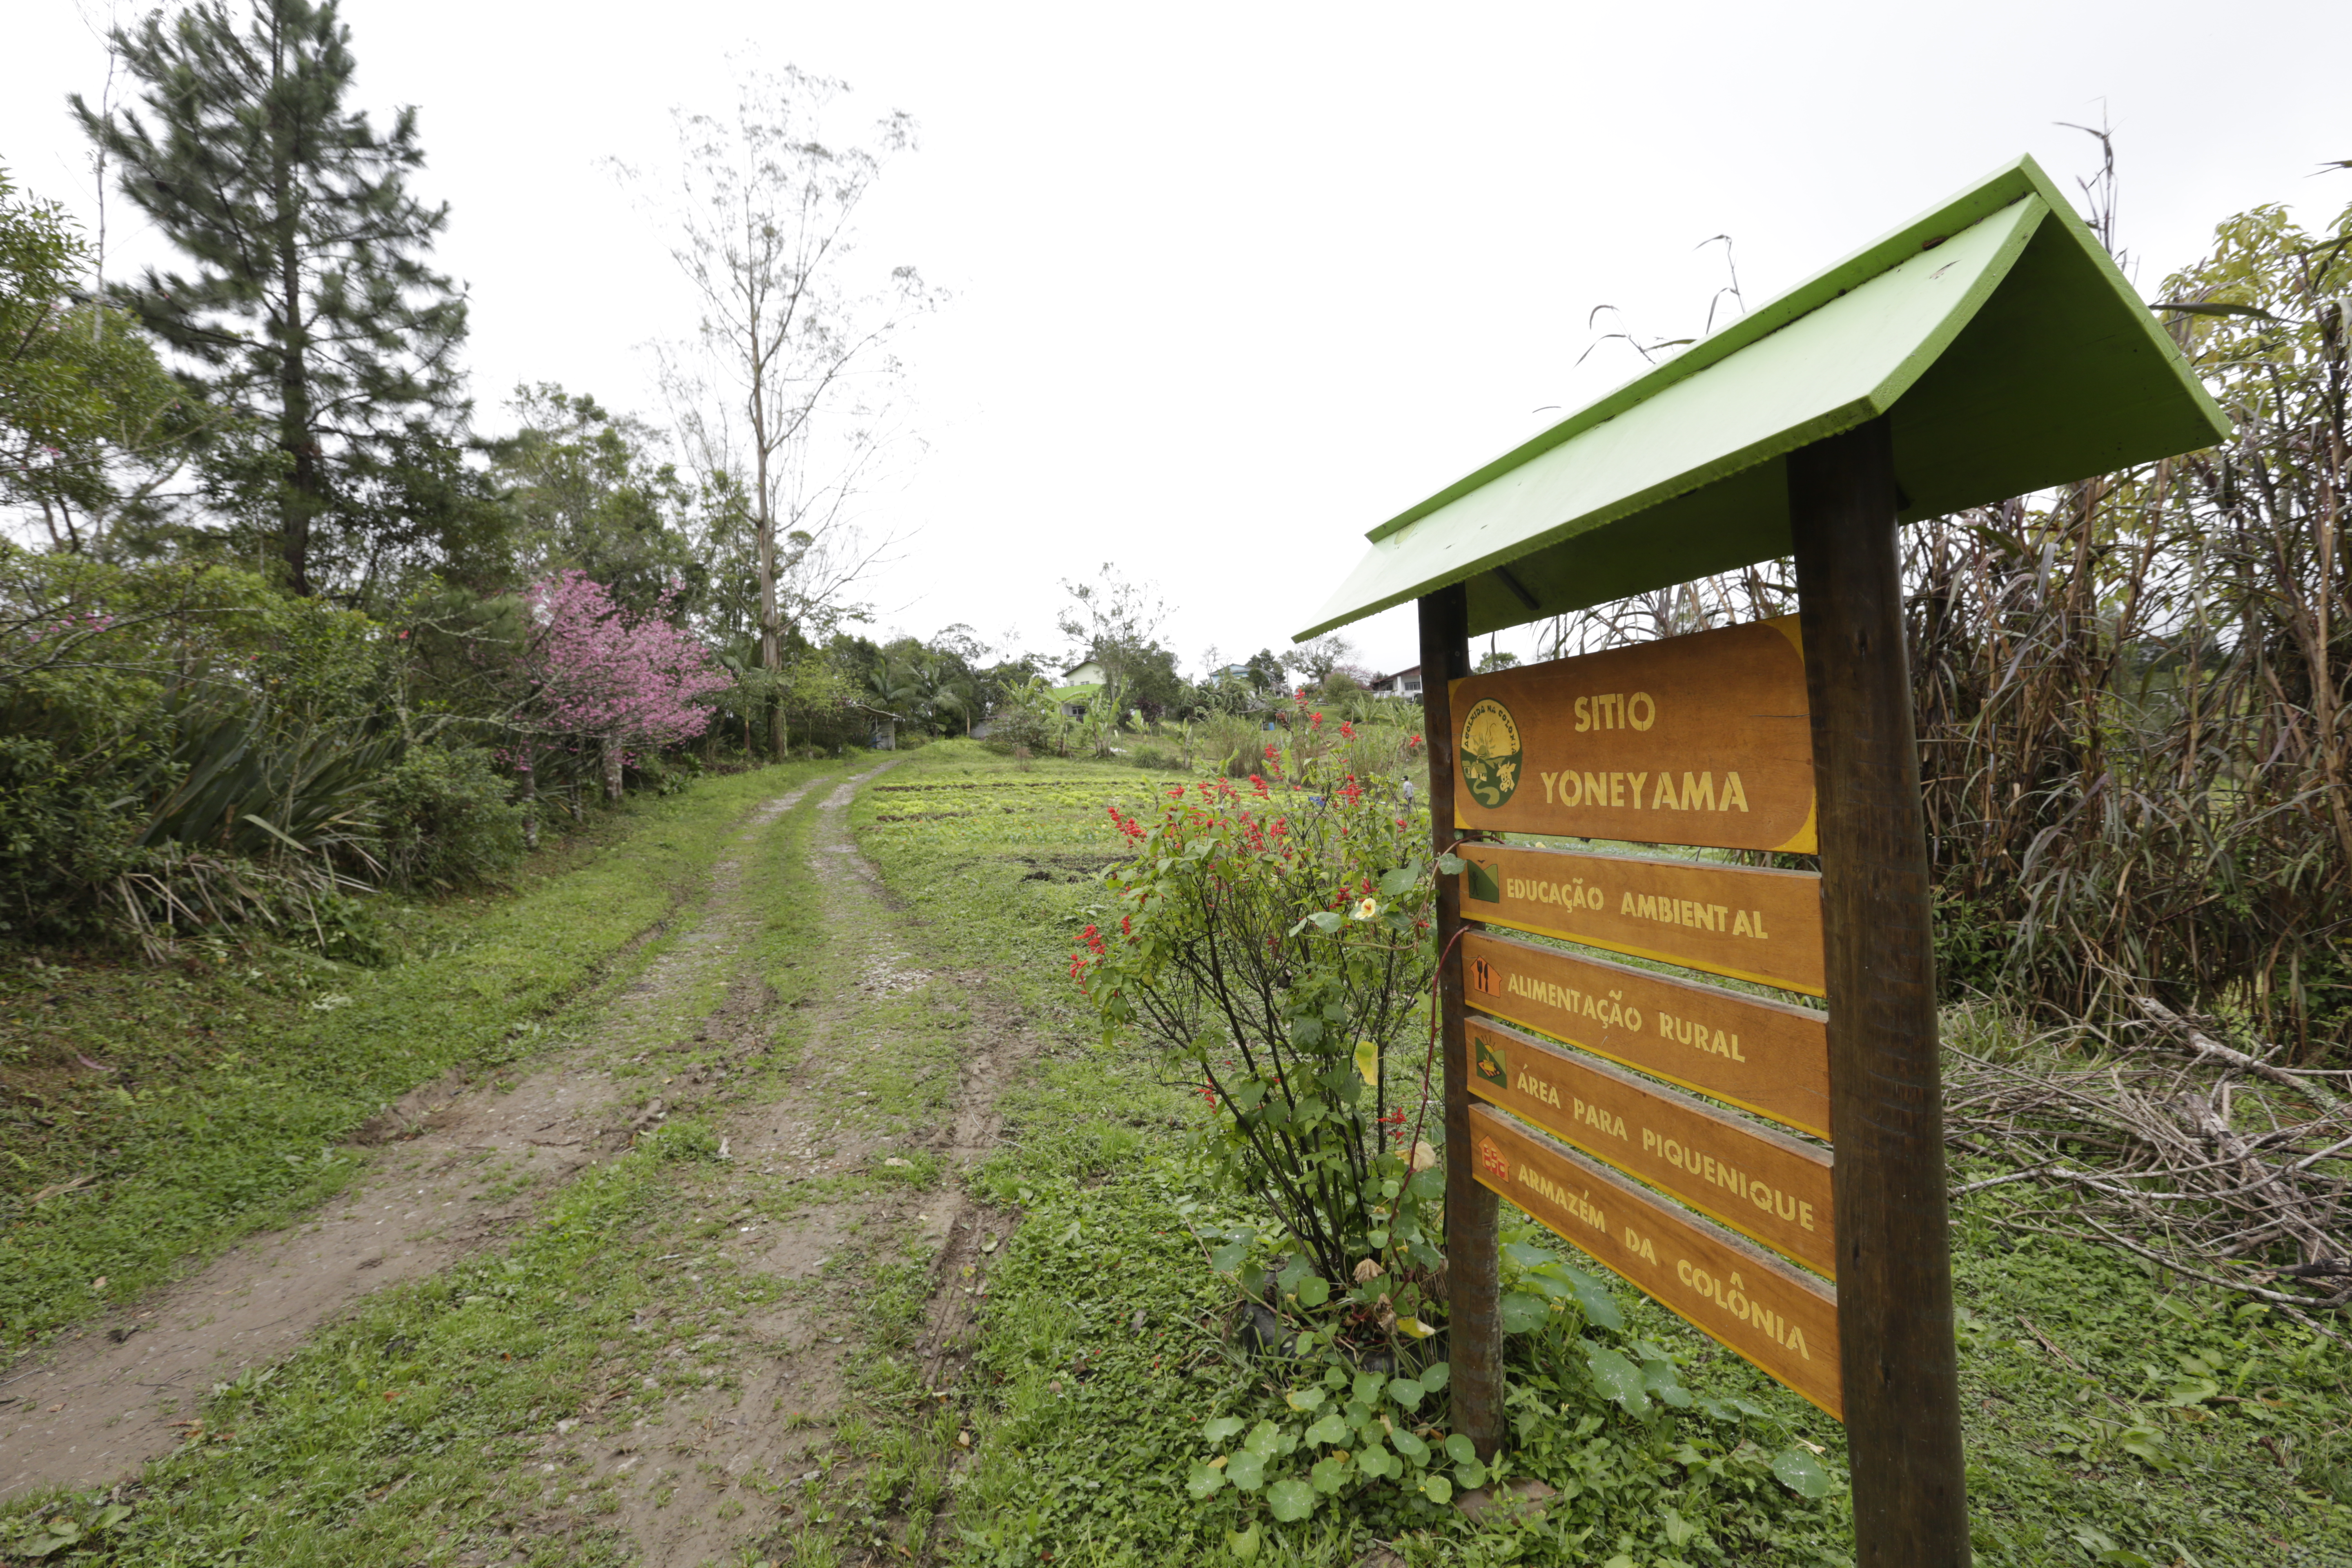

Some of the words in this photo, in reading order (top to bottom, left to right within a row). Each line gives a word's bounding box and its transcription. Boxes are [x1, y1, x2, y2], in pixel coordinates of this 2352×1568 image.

[1464, 705, 1486, 749] ACOLHIDA
[1487, 705, 1496, 714] NA
[1498, 710, 1517, 755] COLONIA
[1575, 691, 1655, 732] SITIO
[1540, 769, 1749, 812] YONEYAMA
[1507, 878, 1604, 913] EDUCAÇÃO
[1620, 892, 1768, 939] AMBIENTAL
[1508, 973, 1642, 1032] ALIMENTAÇÃO
[1659, 1012, 1746, 1063] RURAL
[1517, 1063, 1561, 1109] ÁREA
[1573, 1097, 1628, 1141] PARA
[1642, 1127, 1814, 1232] PIQUENIQUE
[1518, 1164, 1606, 1233] ARMAZÉM
[1625, 1227, 1657, 1266] DA
[1677, 1259, 1810, 1361] COLÔNIA
